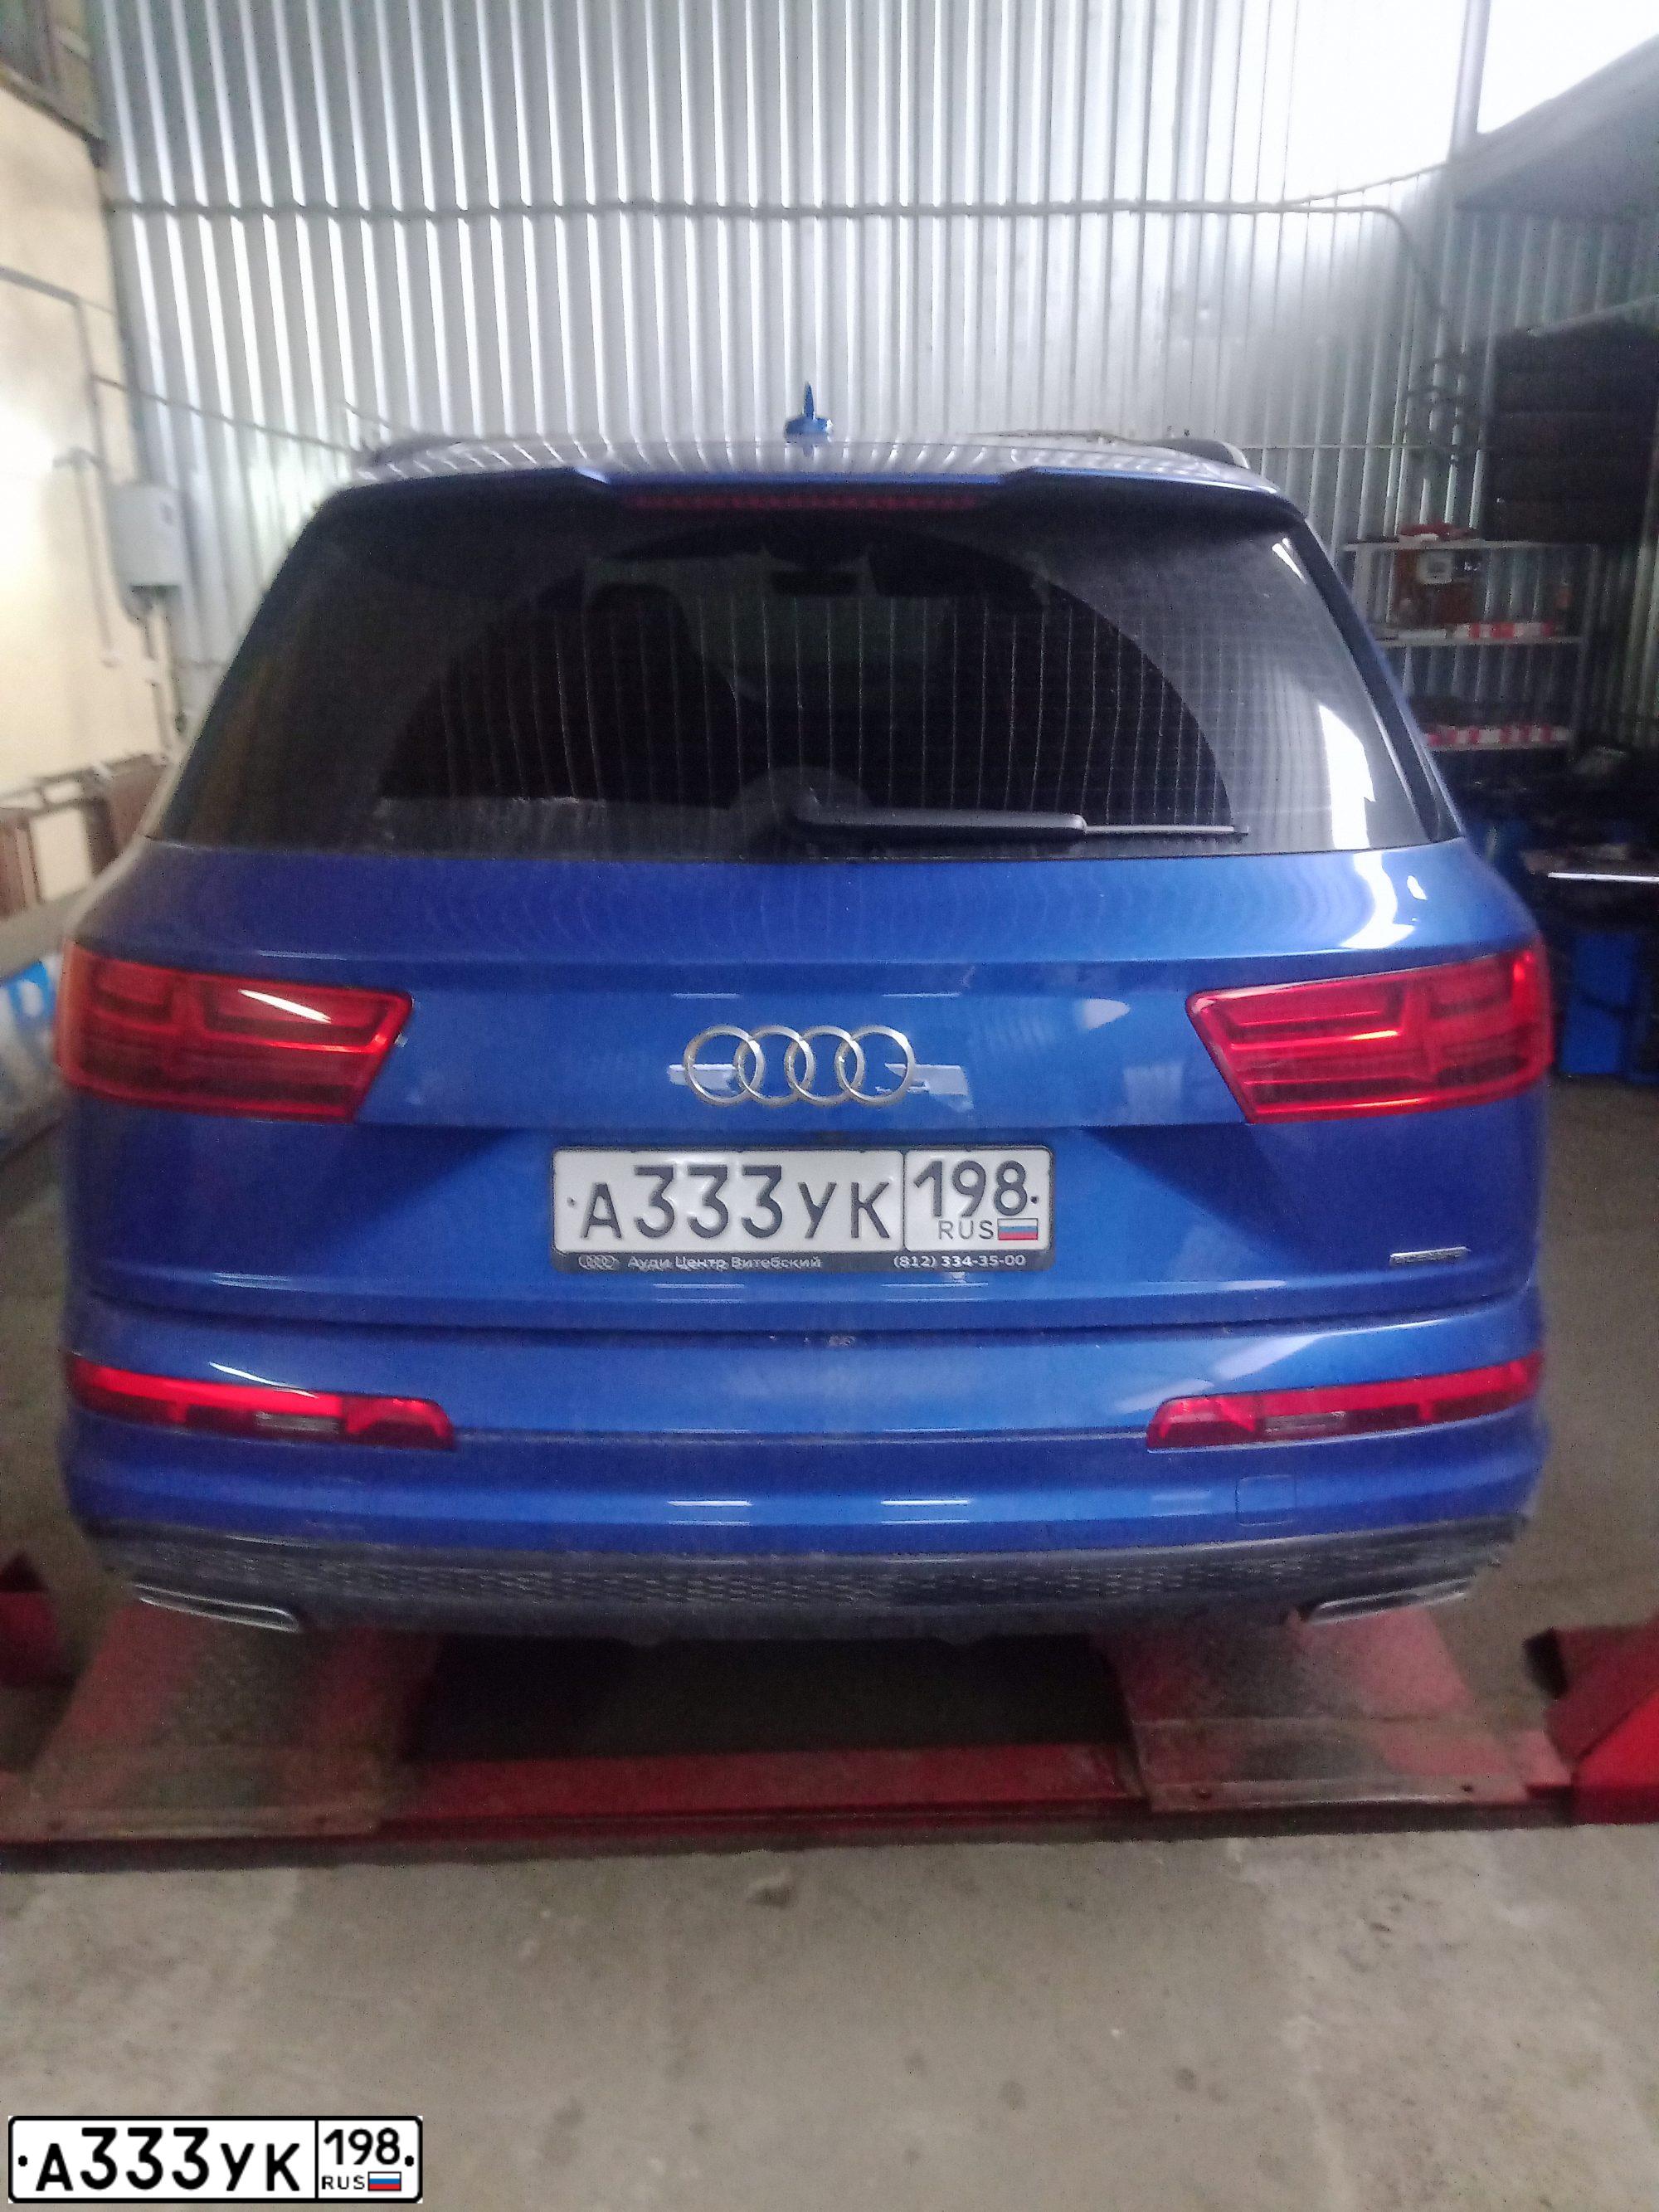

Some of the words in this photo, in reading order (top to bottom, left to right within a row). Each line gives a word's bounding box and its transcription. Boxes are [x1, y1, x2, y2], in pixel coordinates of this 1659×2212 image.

[913, 1161, 1028, 1217] 198
[937, 1220, 994, 1240] RUS
[627, 1256, 671, 1271] Ауди
[674, 1256, 728, 1271] Центр
[731, 1255, 822, 1269] Витебский
[893, 1256, 936, 1269] (812)
[941, 1255, 1026, 1267] 334-35-00
